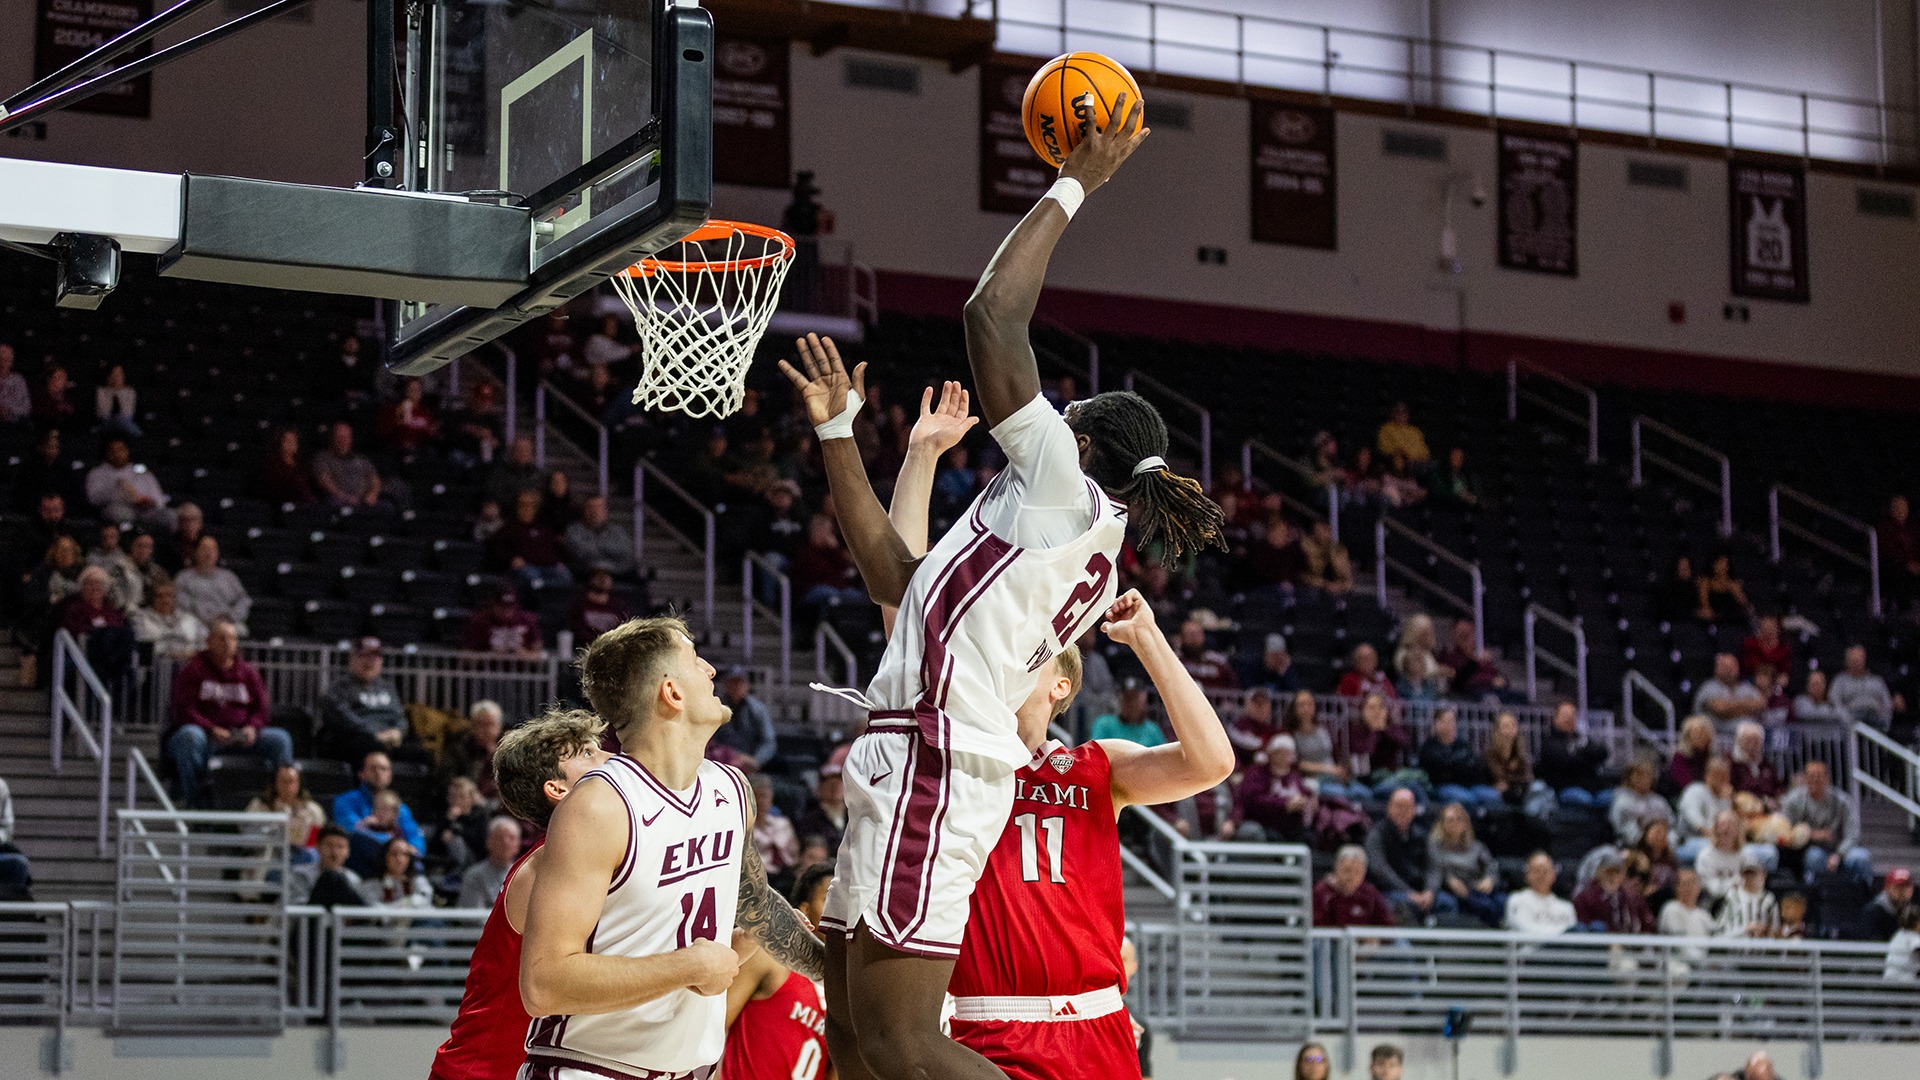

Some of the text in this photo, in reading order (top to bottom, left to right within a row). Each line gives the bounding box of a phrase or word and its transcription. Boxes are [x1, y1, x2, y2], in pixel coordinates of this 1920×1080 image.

[1015, 778, 1091, 812] IAMI
[660, 829, 735, 877] EKU
[1013, 812, 1067, 884] 11
[675, 886, 718, 951] 14
[789, 1001, 826, 1036] MIA
[791, 1037, 822, 1080] 0
